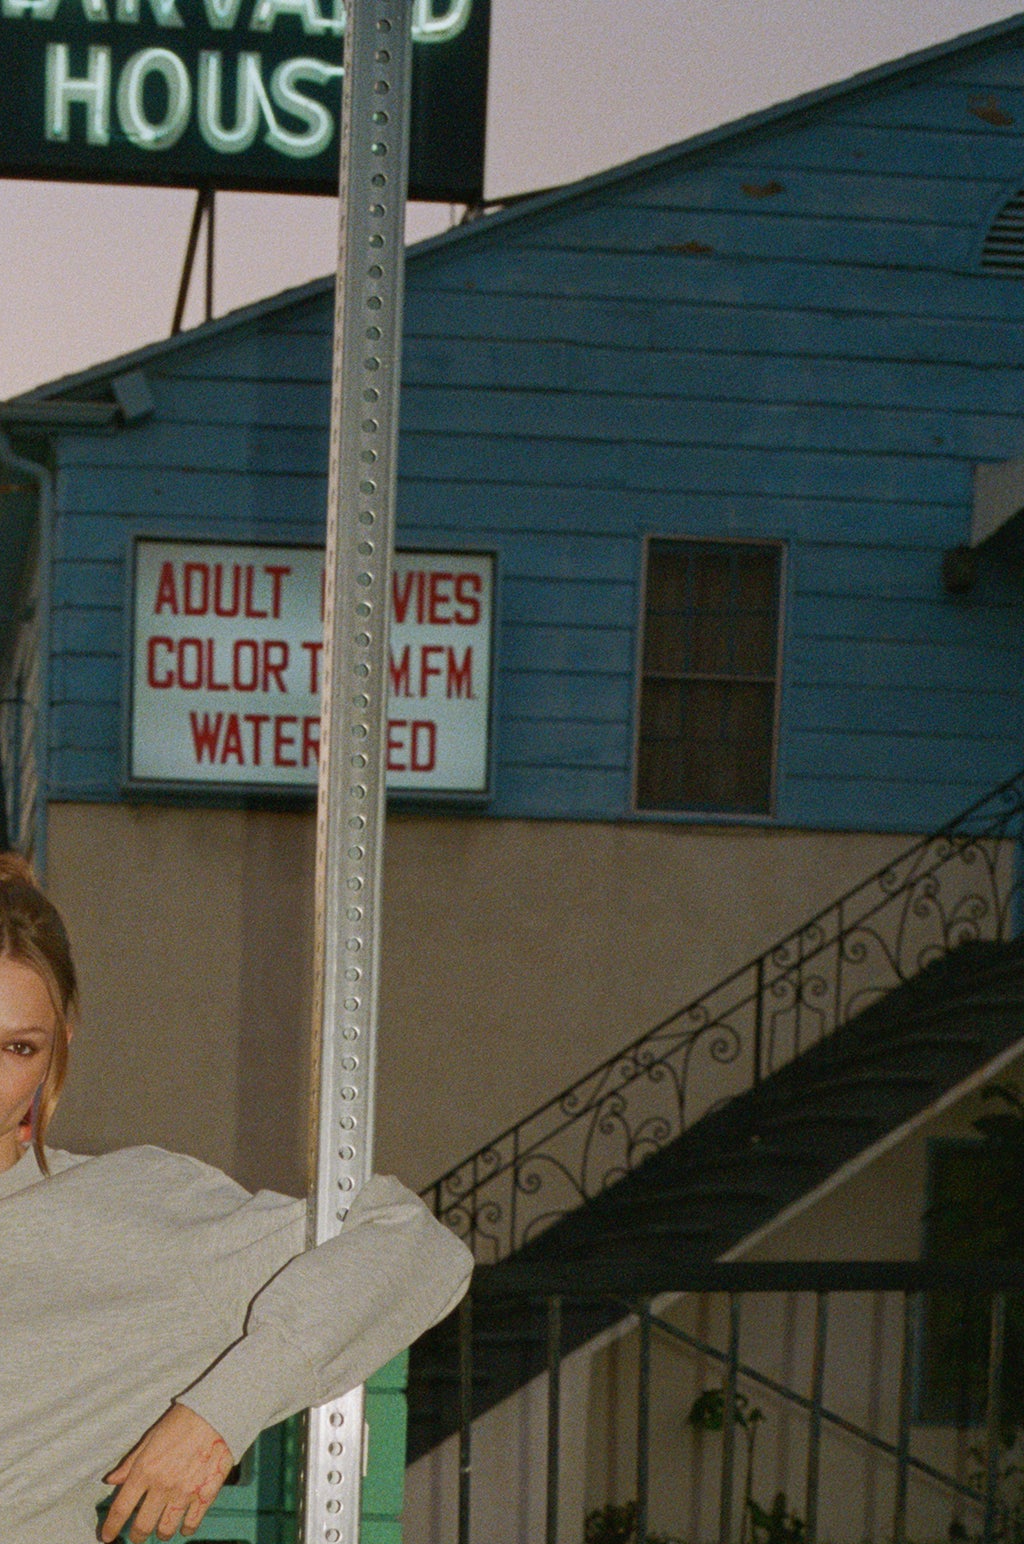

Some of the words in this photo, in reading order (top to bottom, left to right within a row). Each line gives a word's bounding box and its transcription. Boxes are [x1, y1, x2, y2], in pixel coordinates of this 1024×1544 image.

[44, 43, 345, 157] HOUS
[154, 561, 291, 620] ADULT
[320, 569, 483, 627] VIES
[146, 636, 289, 694] COLOR
